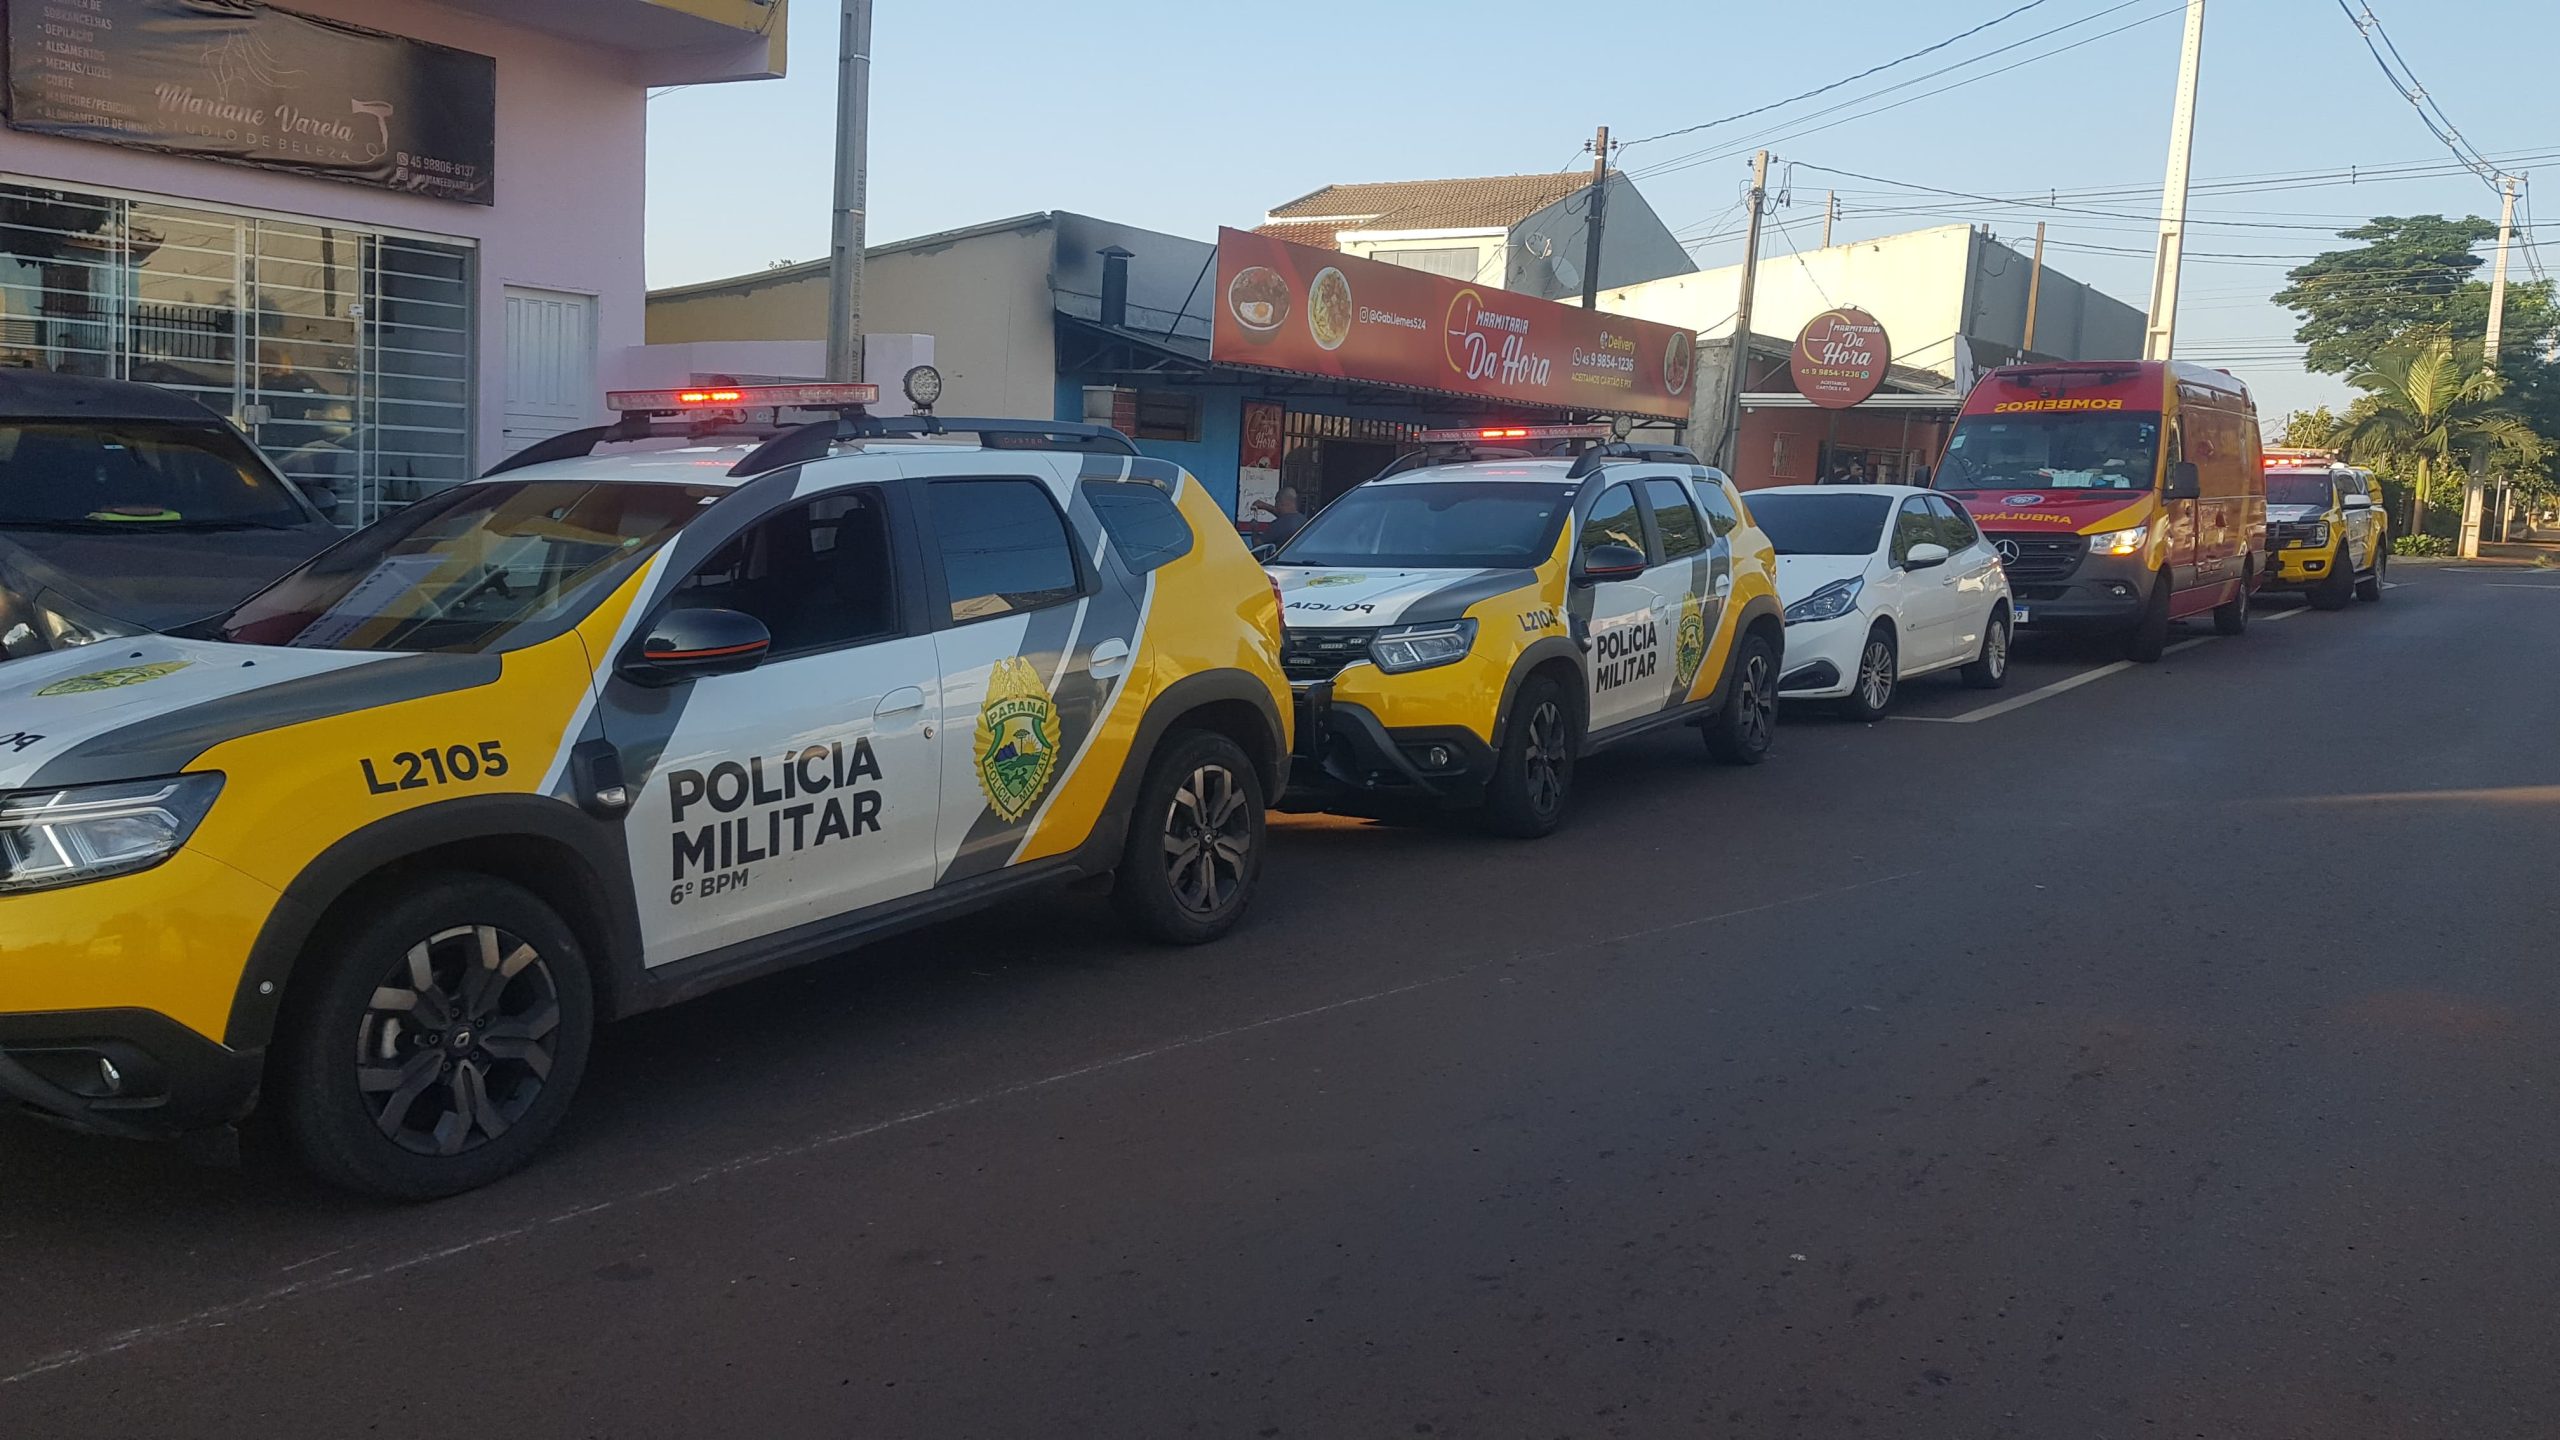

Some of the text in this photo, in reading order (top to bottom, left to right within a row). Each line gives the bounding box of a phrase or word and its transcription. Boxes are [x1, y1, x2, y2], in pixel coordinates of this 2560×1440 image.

[154, 82, 354, 142] Mariane Varela
[157, 118, 351, 162] STUDIO DE BELEZA
[410, 155, 421, 168] 45
[1475, 310, 1529, 335] MARMITARIA
[1833, 325, 1880, 334] MARMITARIA
[1608, 335, 1636, 354] Delivery
[1842, 332, 1866, 348] Da
[1465, 332, 1551, 386] Da Hora
[1582, 352, 1634, 372] 45 9 9854-1236
[1823, 342, 1873, 366] Hora
[1516, 607, 1559, 632] L2104
[1596, 651, 1657, 693] MILITAR
[989, 701, 1045, 725] PARANÁ
[359, 740, 509, 795] L2105
[668, 736, 883, 823] POLÍCIA
[672, 790, 882, 881] MILITAR
[699, 868, 749, 898] BPM
